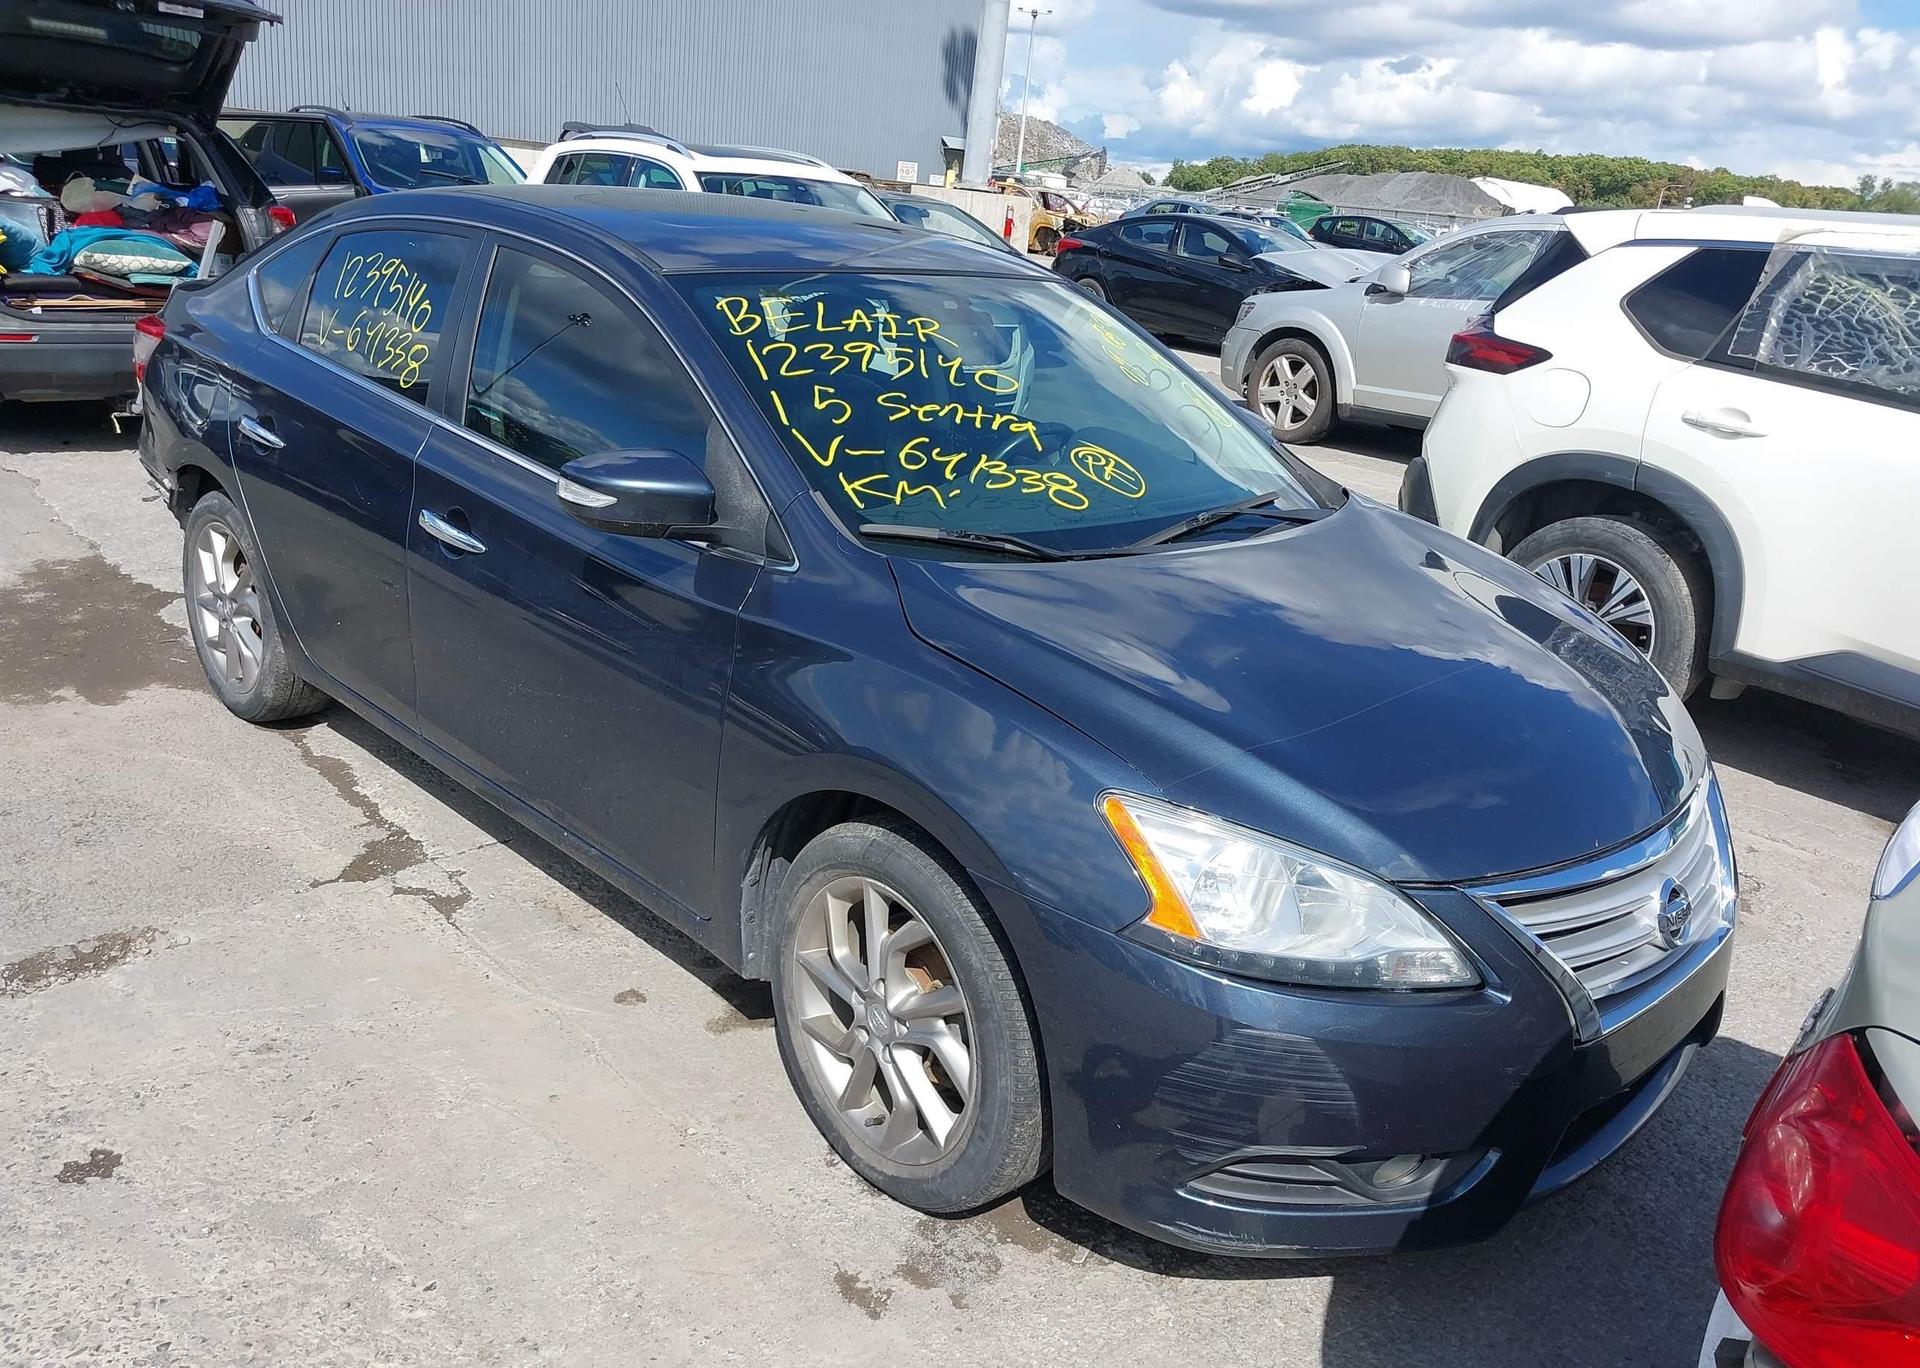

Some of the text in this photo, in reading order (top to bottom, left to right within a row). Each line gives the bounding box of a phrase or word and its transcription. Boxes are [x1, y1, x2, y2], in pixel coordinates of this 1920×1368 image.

[334, 251, 432, 332] 12395140
[716, 296, 959, 347] BELAIR
[746, 339, 1019, 392] 12395140
